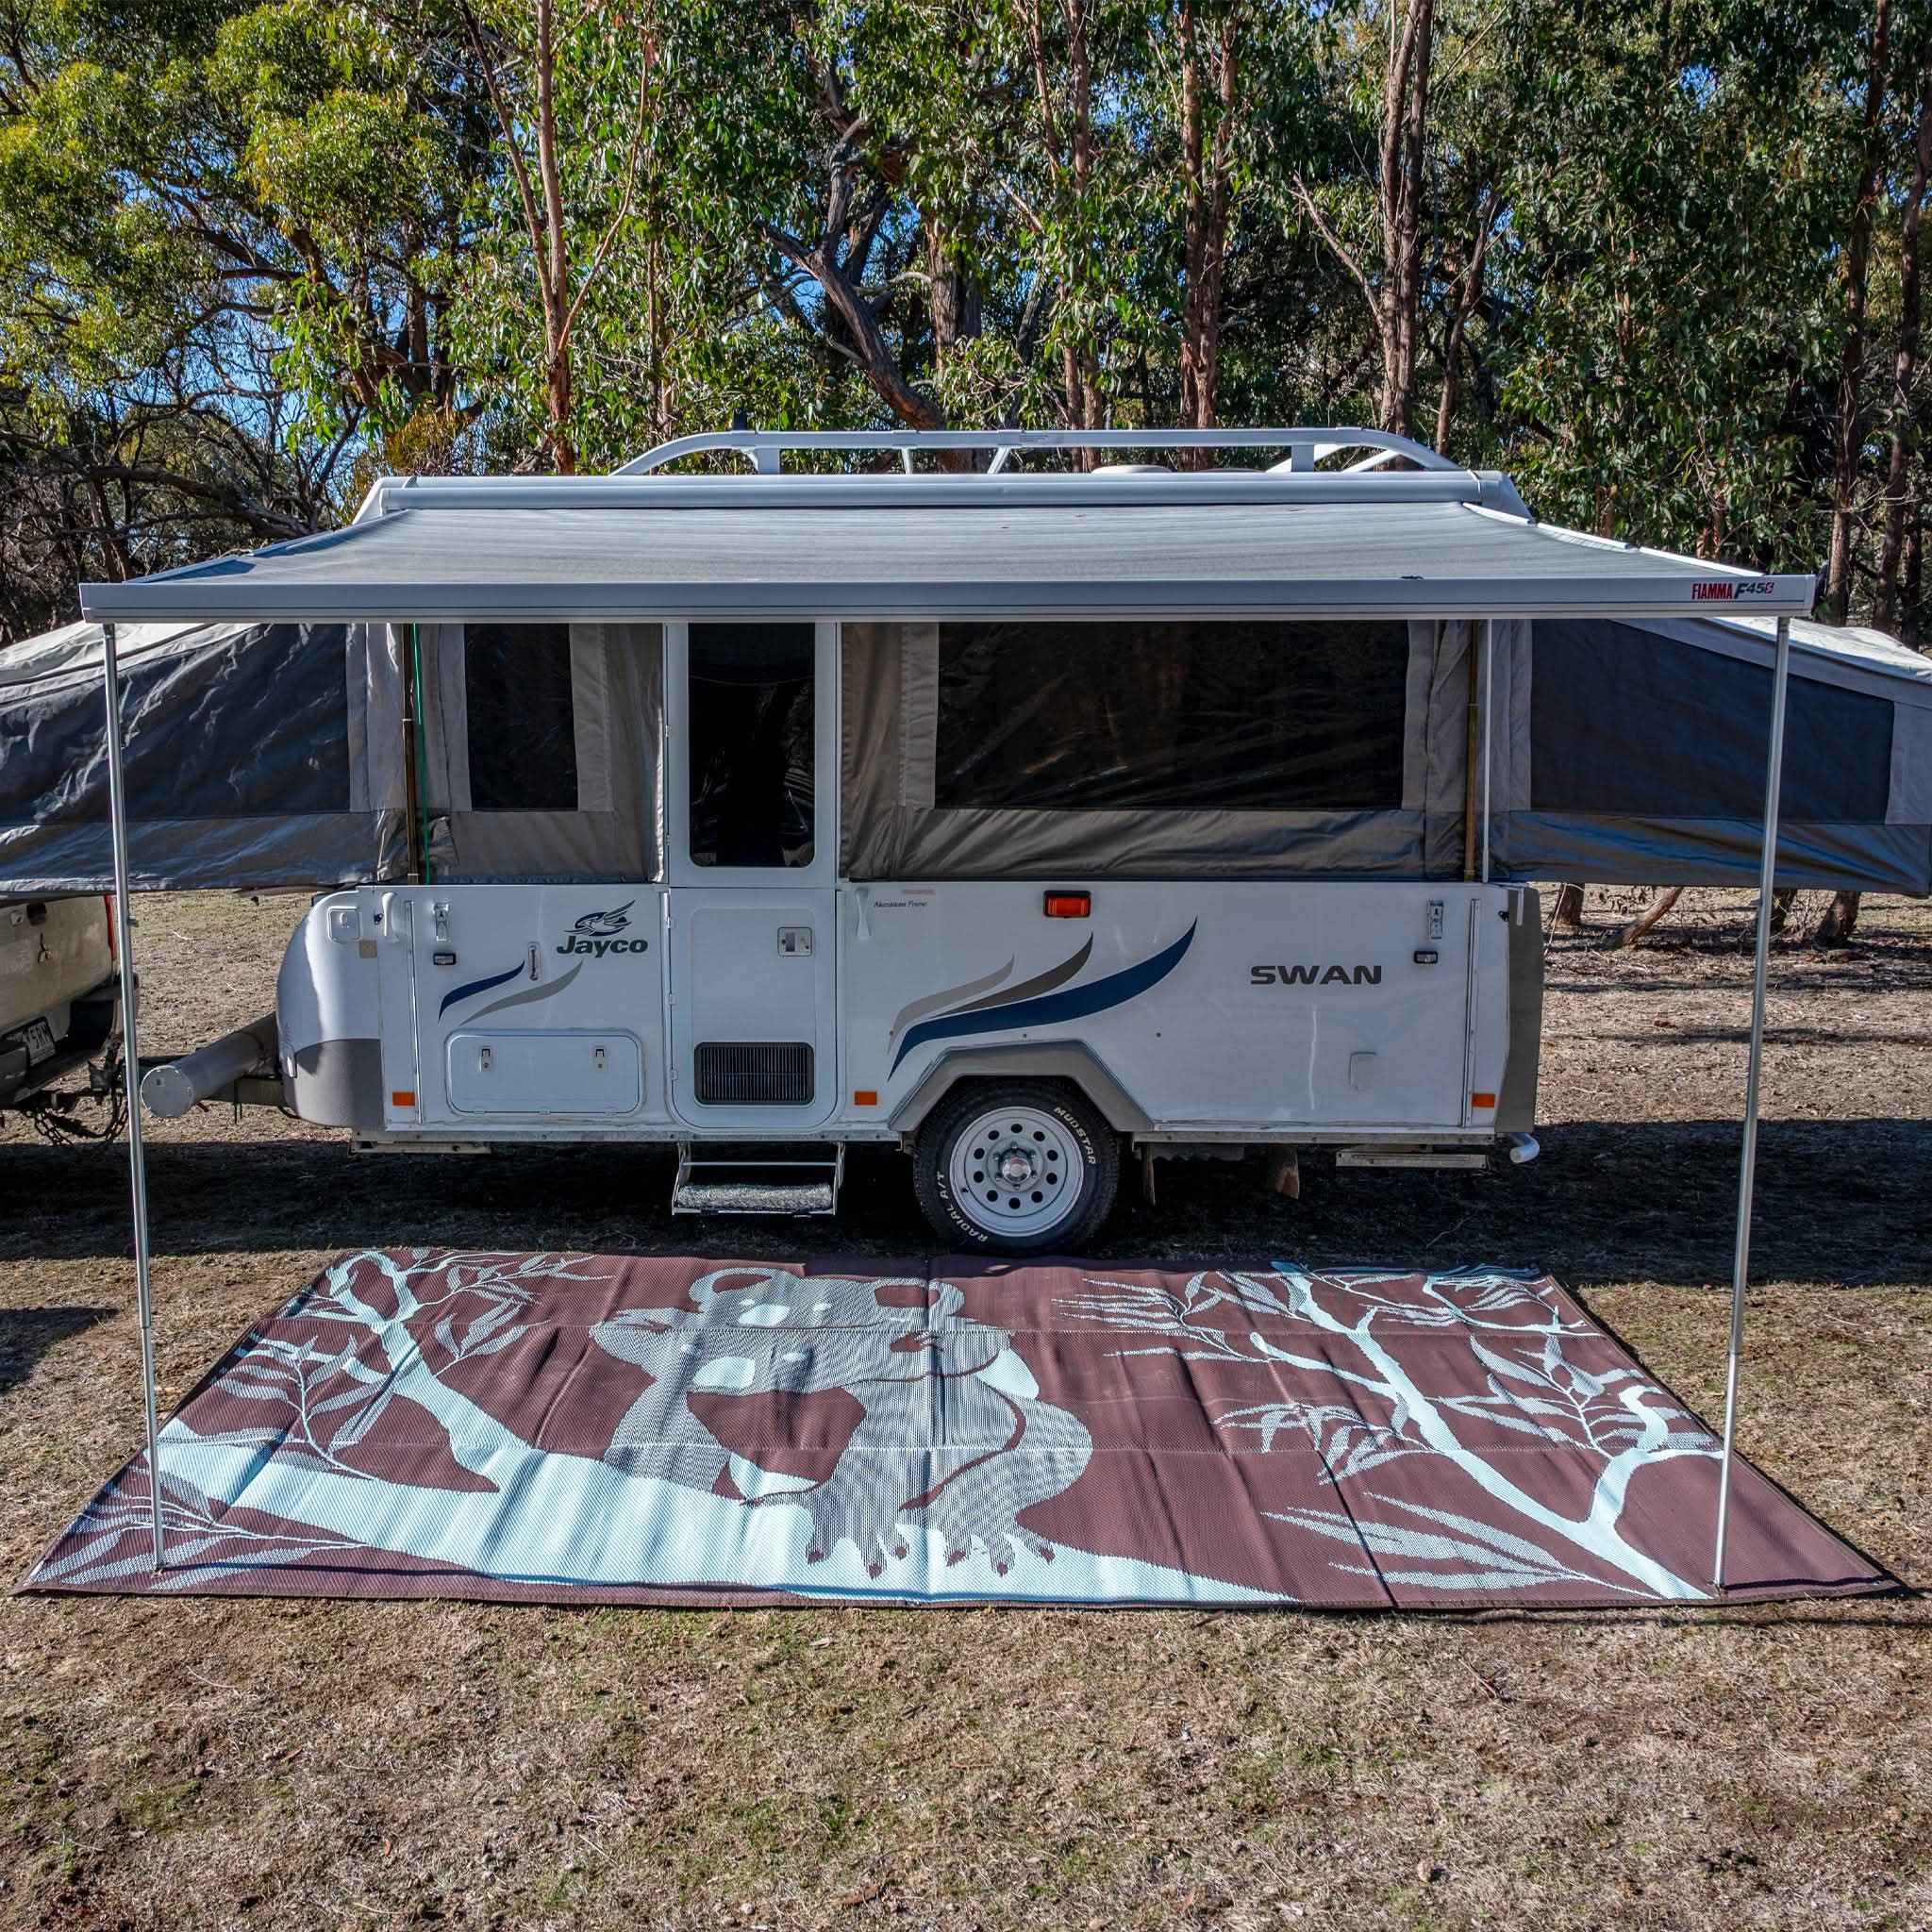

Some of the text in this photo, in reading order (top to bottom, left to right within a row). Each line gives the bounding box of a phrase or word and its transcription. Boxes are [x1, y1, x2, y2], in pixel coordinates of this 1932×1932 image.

[1691, 583, 1733, 600] FIAMMA
[557, 935, 648, 958] Jayco
[1250, 965, 1382, 985] SWAN
[1054, 1107, 1096, 1164] MUDSTAR
[936, 1171, 988, 1242] RADIAL A/T
